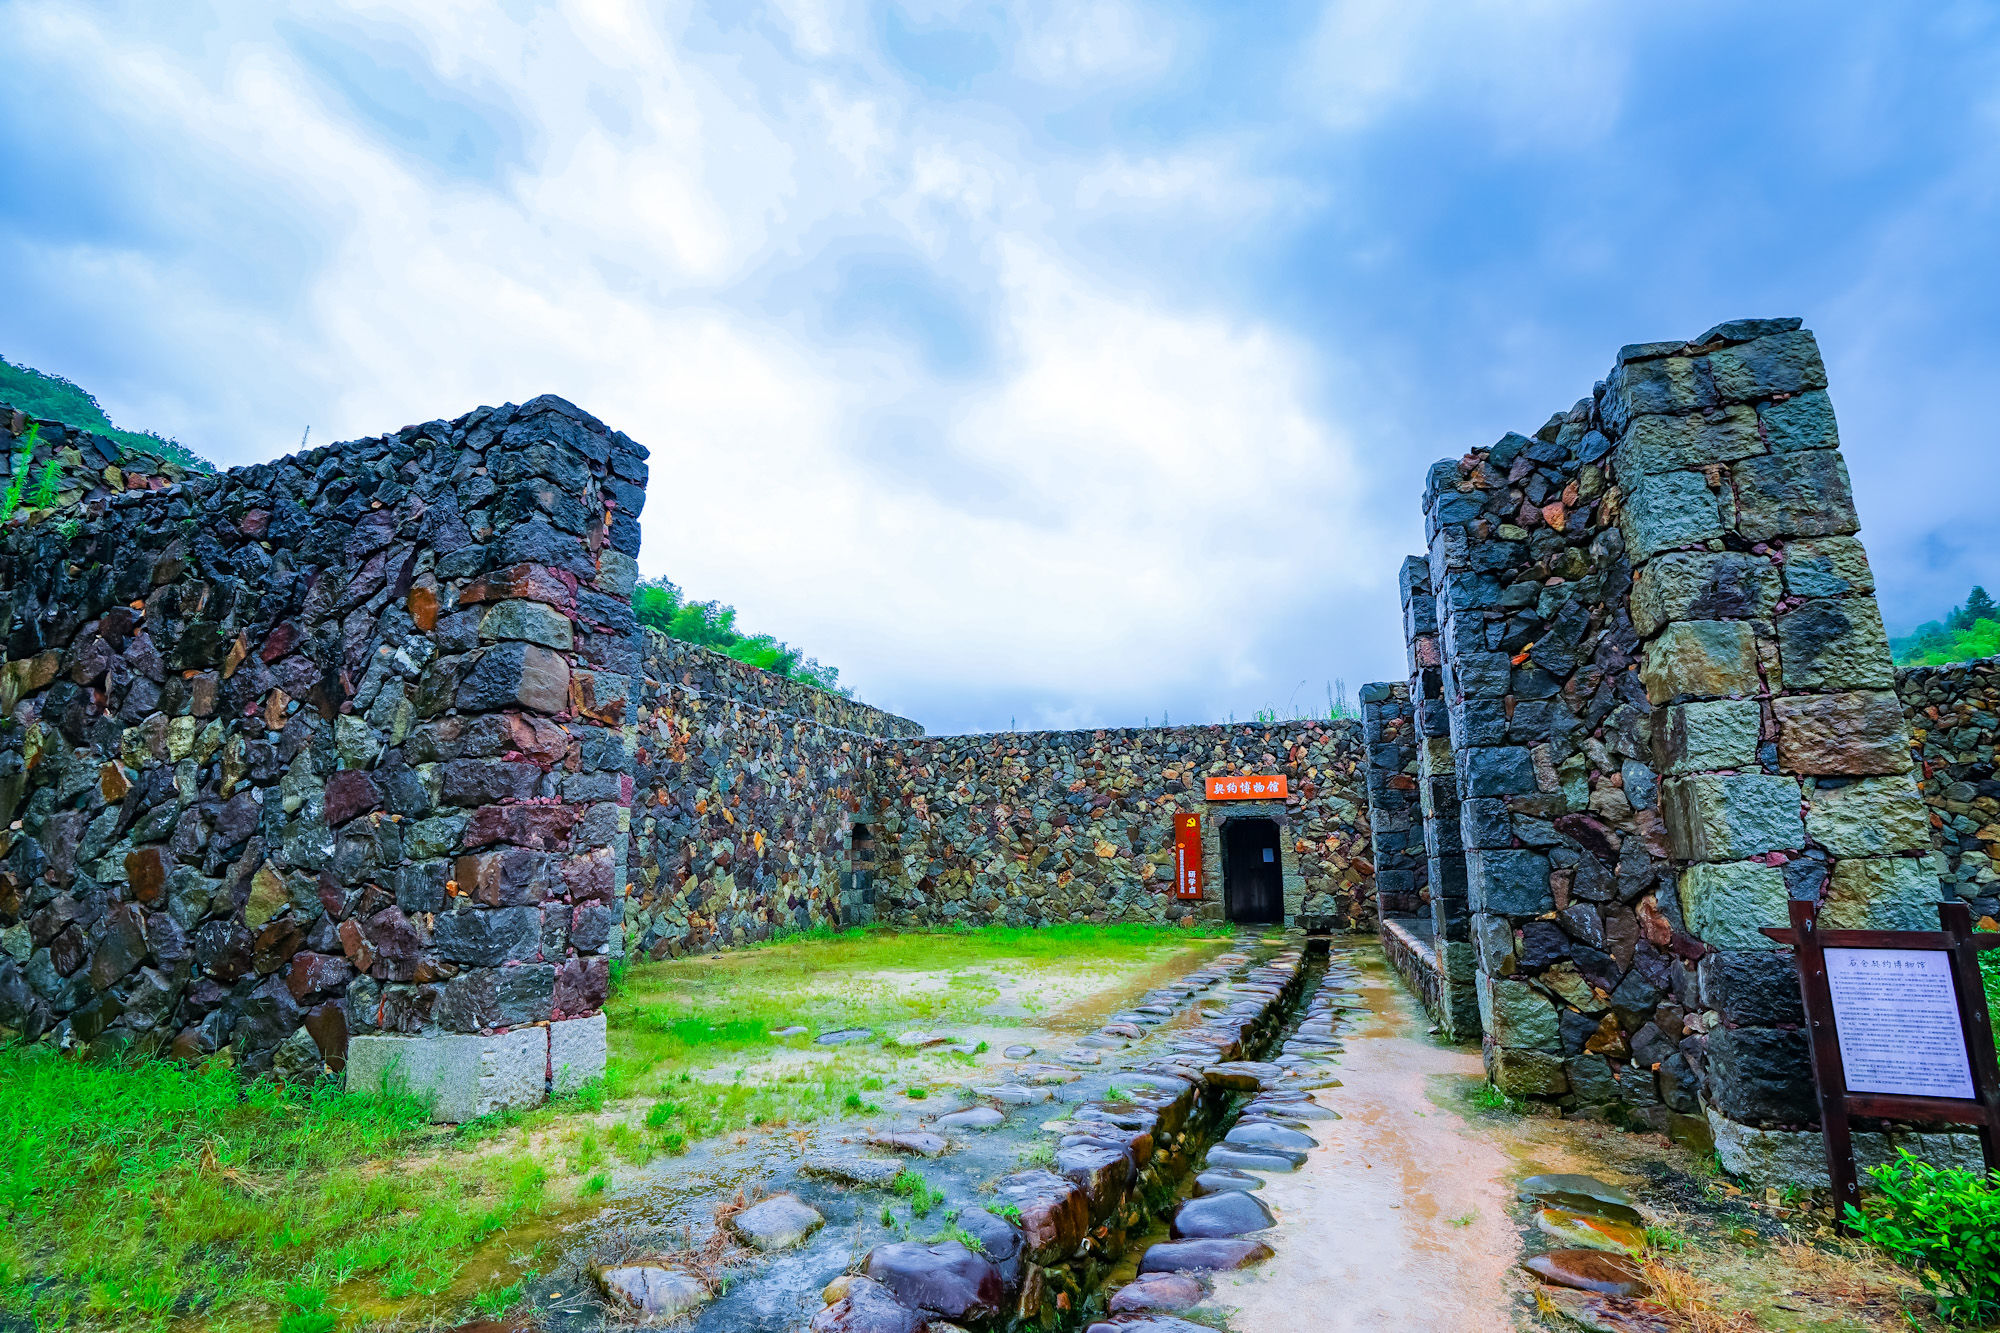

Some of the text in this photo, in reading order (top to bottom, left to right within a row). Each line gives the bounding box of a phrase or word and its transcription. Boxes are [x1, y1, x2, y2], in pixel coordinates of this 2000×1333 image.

[1213, 781, 1279, 795] 契约博物馆
[1188, 870, 1196, 894] 研学点
[1848, 959, 1927, 969] 石仓契约博物馆
